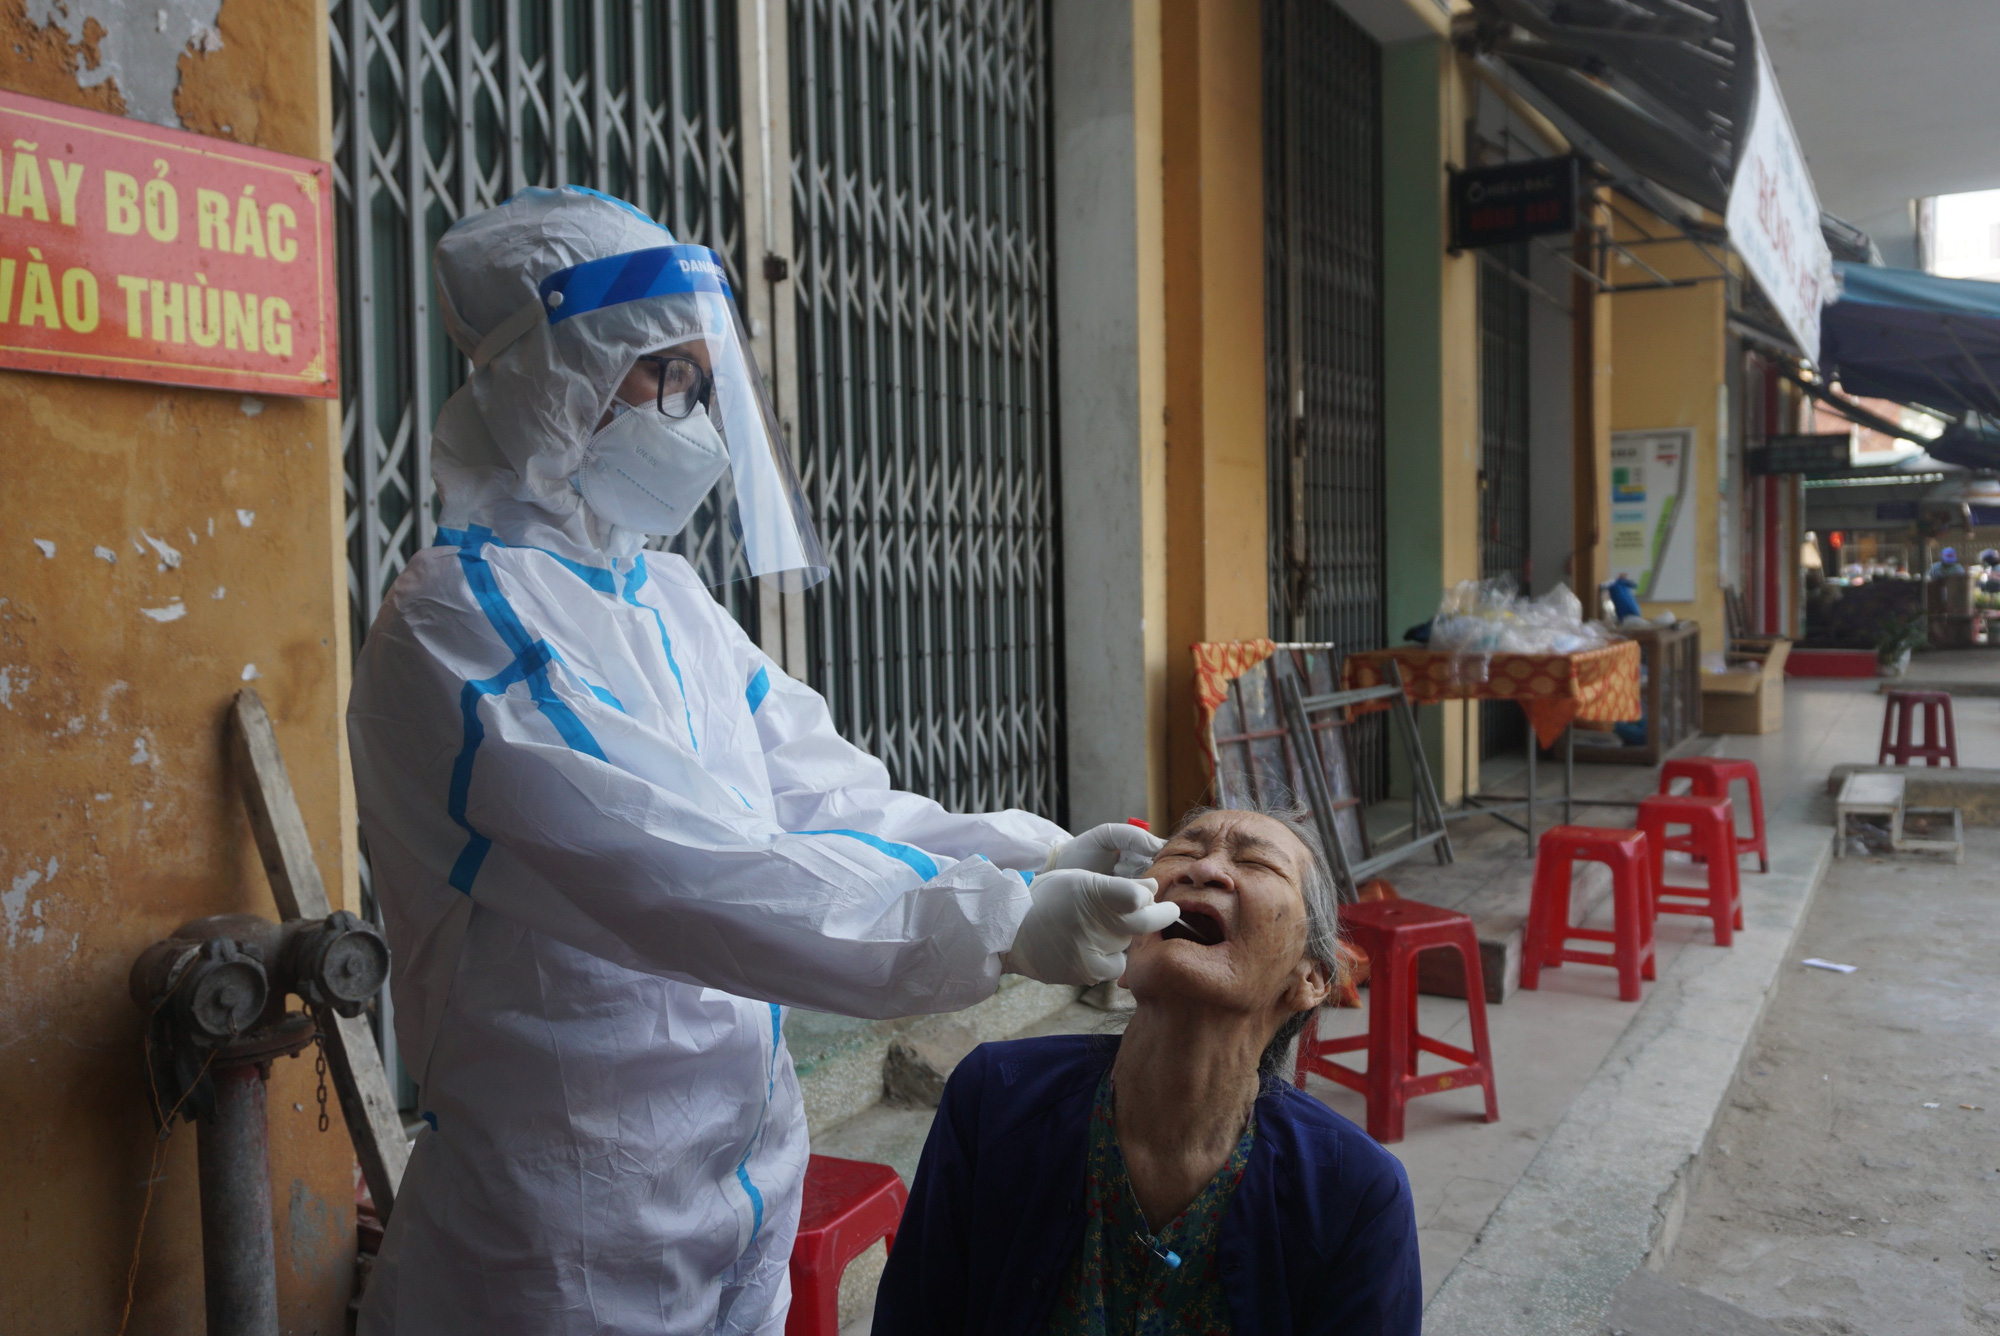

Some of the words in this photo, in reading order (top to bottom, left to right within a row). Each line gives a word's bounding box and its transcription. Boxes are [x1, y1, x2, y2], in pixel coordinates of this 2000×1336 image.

[0, 138, 84, 227] ÃY
[104, 158, 178, 243] BỎ
[197, 184, 298, 263] RÁC
[117, 272, 293, 357] THÙNG
